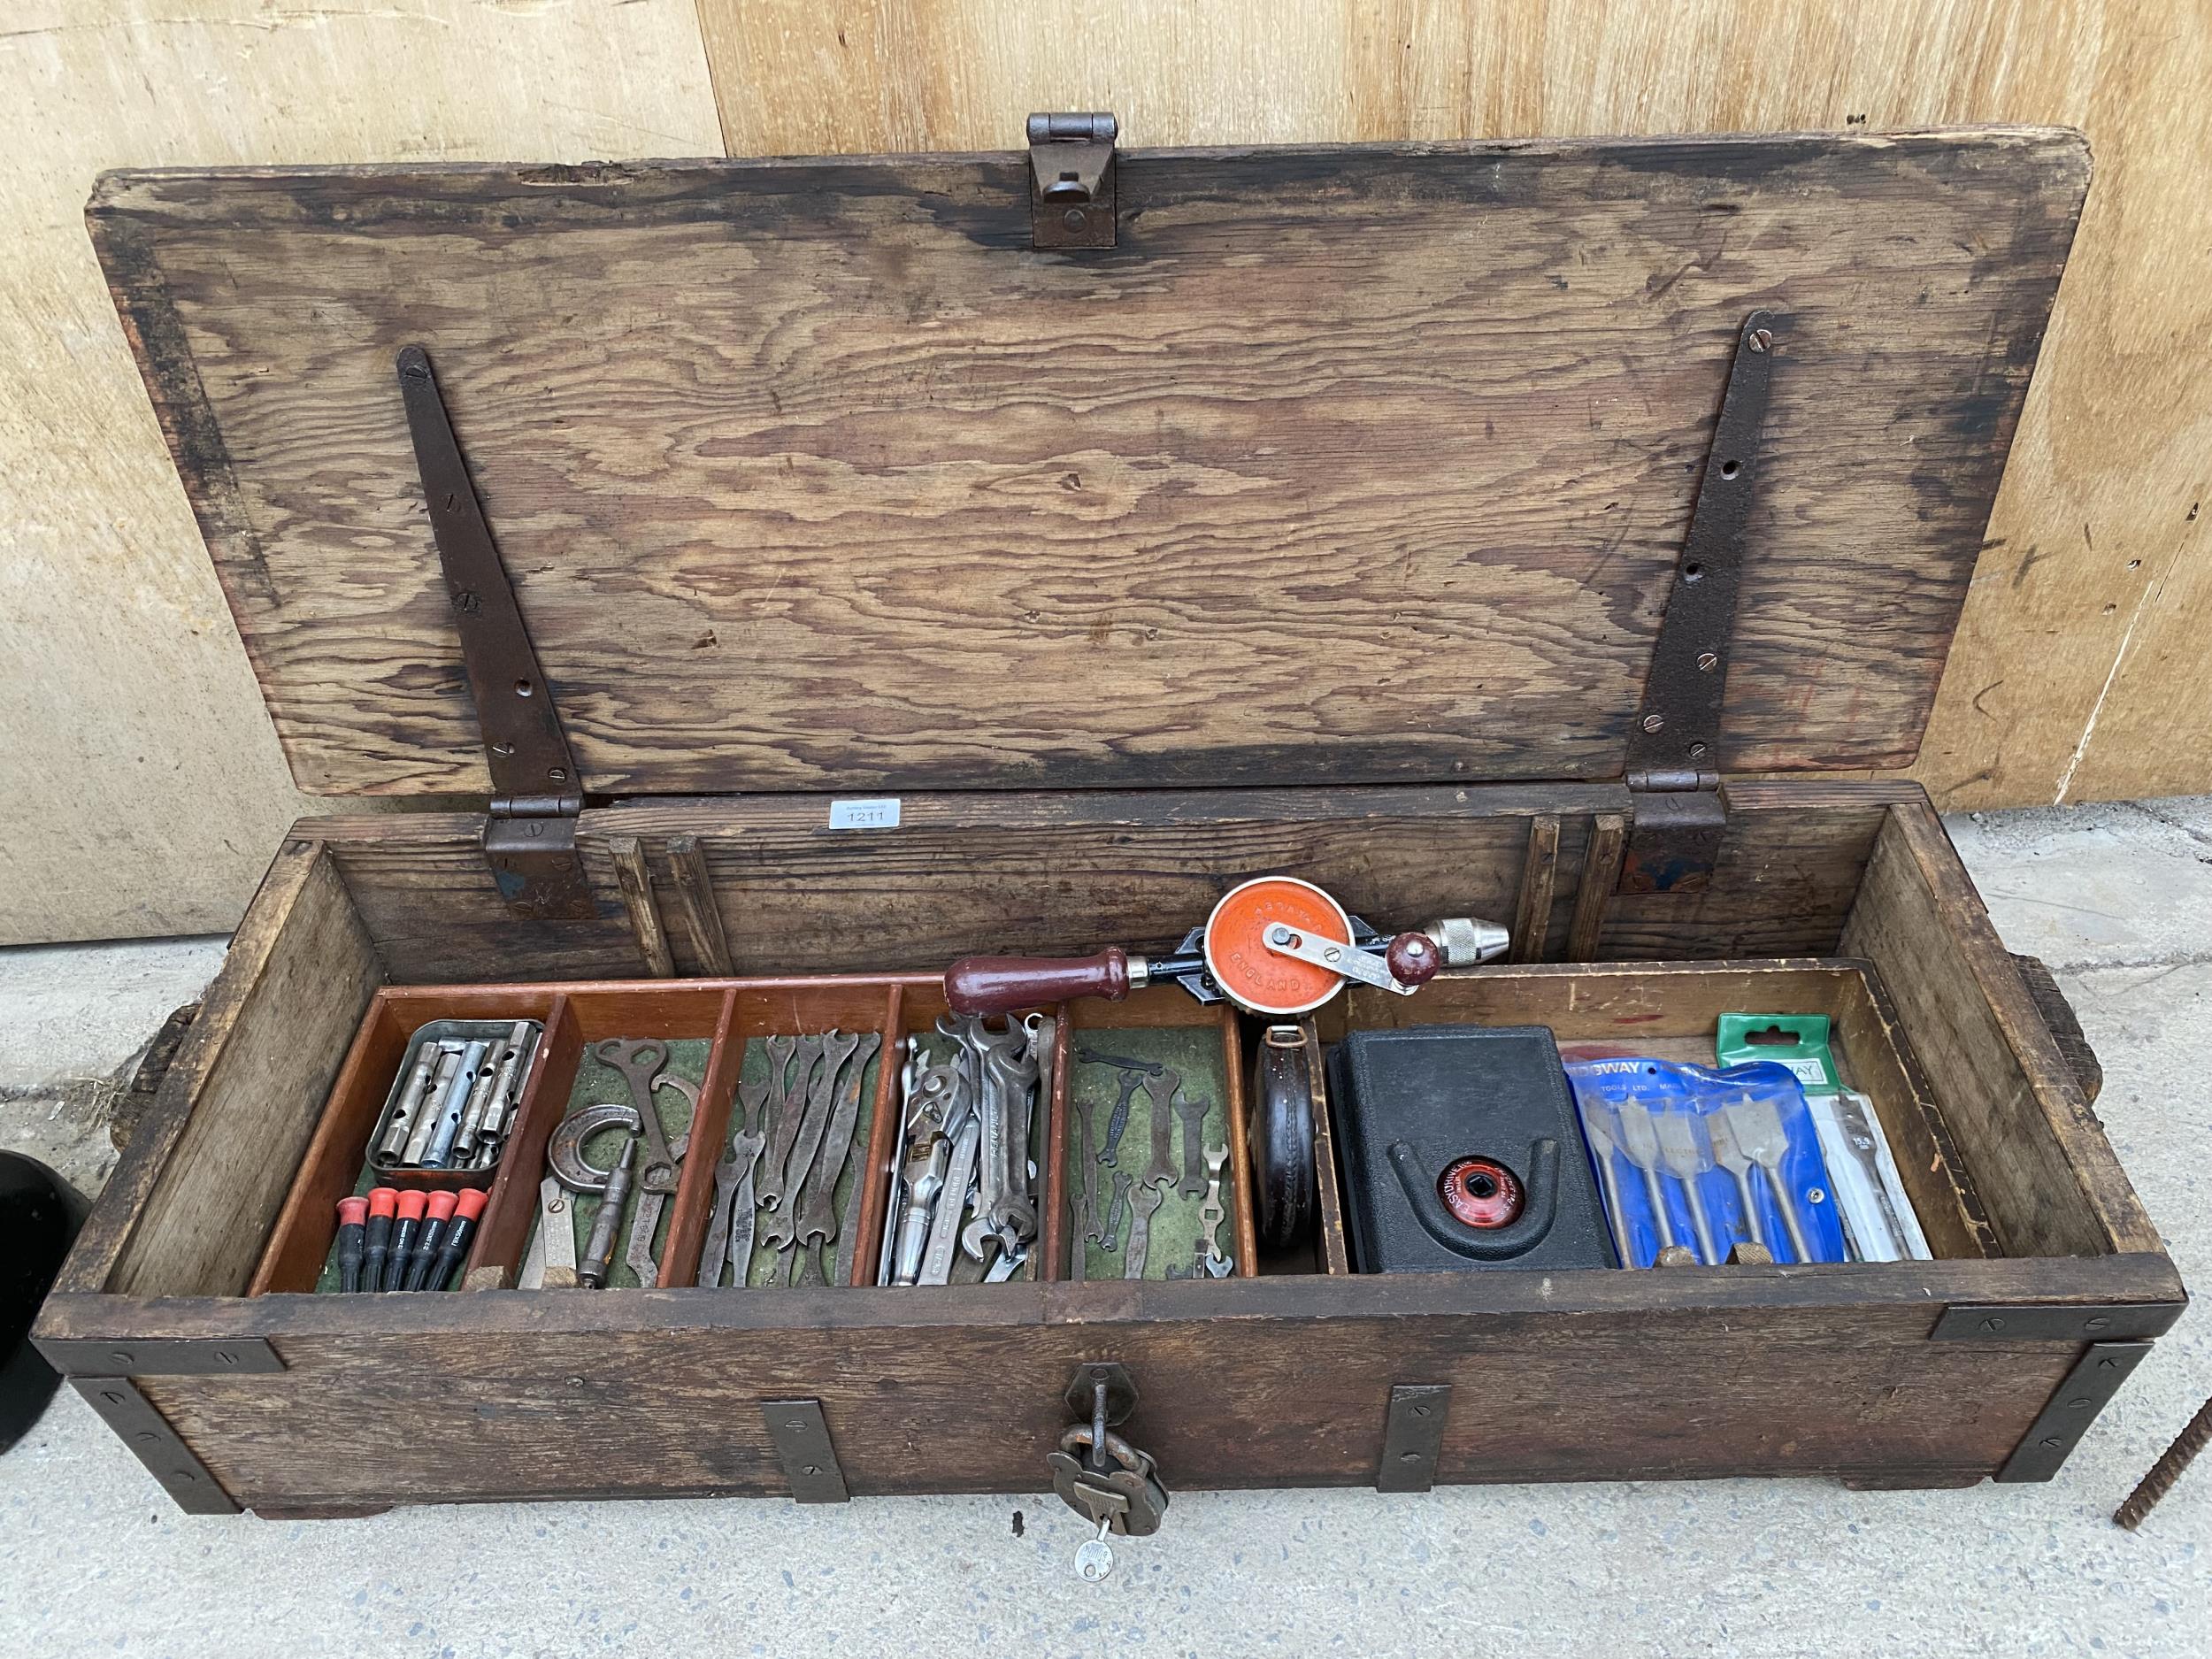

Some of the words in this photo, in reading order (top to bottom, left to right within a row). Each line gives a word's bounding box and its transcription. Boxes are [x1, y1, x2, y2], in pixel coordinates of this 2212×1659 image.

[847, 811, 884, 822] 1211
[1231, 953, 1301, 991] ENGLAND
[989, 1108, 999, 1158] RENAULT
